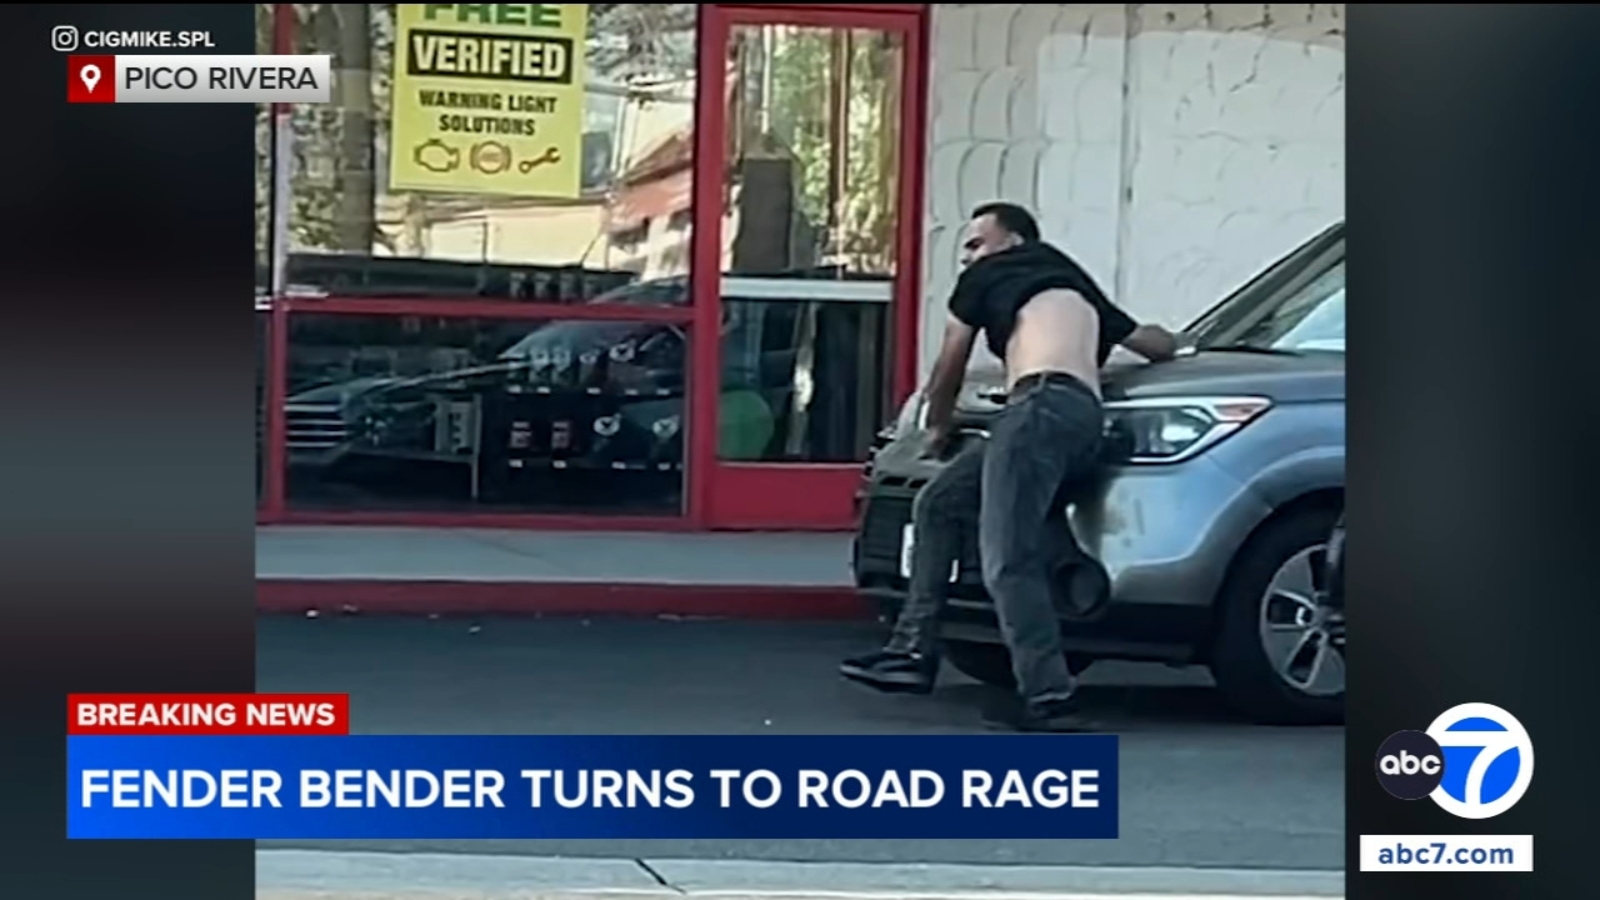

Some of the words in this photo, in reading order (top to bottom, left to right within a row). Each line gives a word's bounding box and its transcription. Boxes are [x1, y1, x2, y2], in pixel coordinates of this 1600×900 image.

[412, 35, 567, 78] VERIFIED
[419, 89, 502, 111] WARNING
[508, 95, 558, 114] LIGHT
[438, 114, 536, 136] SOLUTIONS
